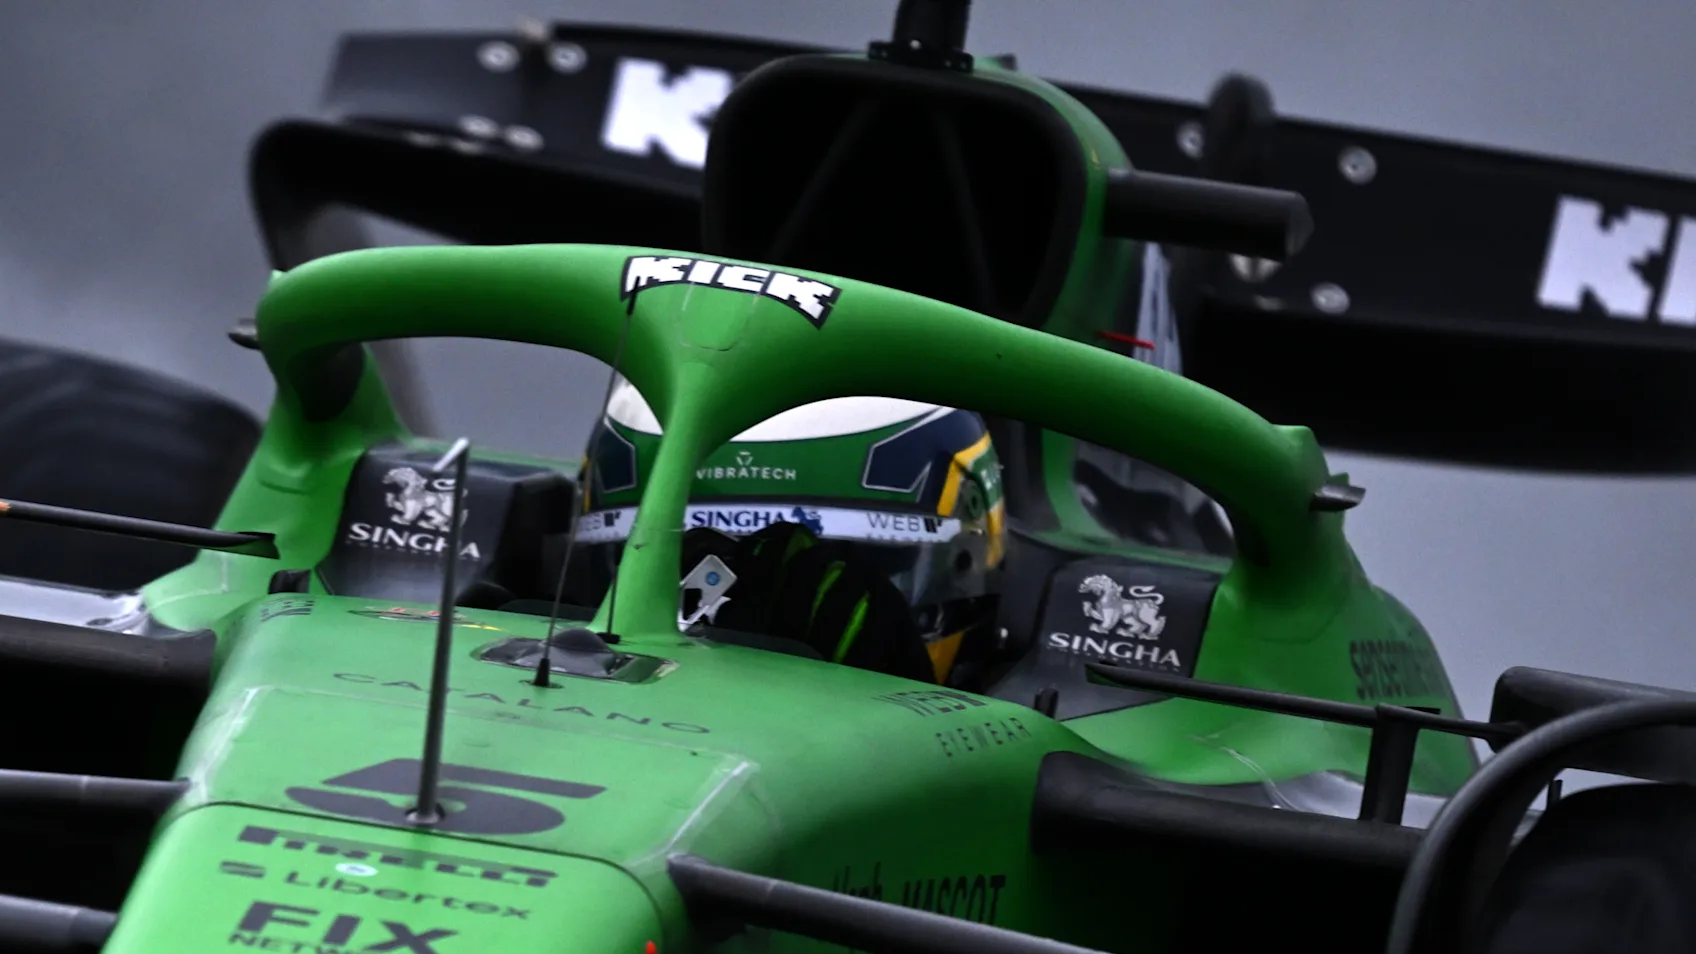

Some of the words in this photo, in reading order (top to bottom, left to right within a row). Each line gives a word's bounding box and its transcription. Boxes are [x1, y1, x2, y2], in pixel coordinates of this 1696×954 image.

[622, 256, 838, 326] KICK
[696, 465, 797, 480] VIBRATECH
[692, 510, 787, 530] SINGHA
[1048, 632, 1181, 667] SINGHA
[935, 716, 1032, 758] EYEWEAR
[286, 757, 607, 836] 5
[237, 825, 559, 888] PIRELLI
[283, 870, 532, 921] Libertex
